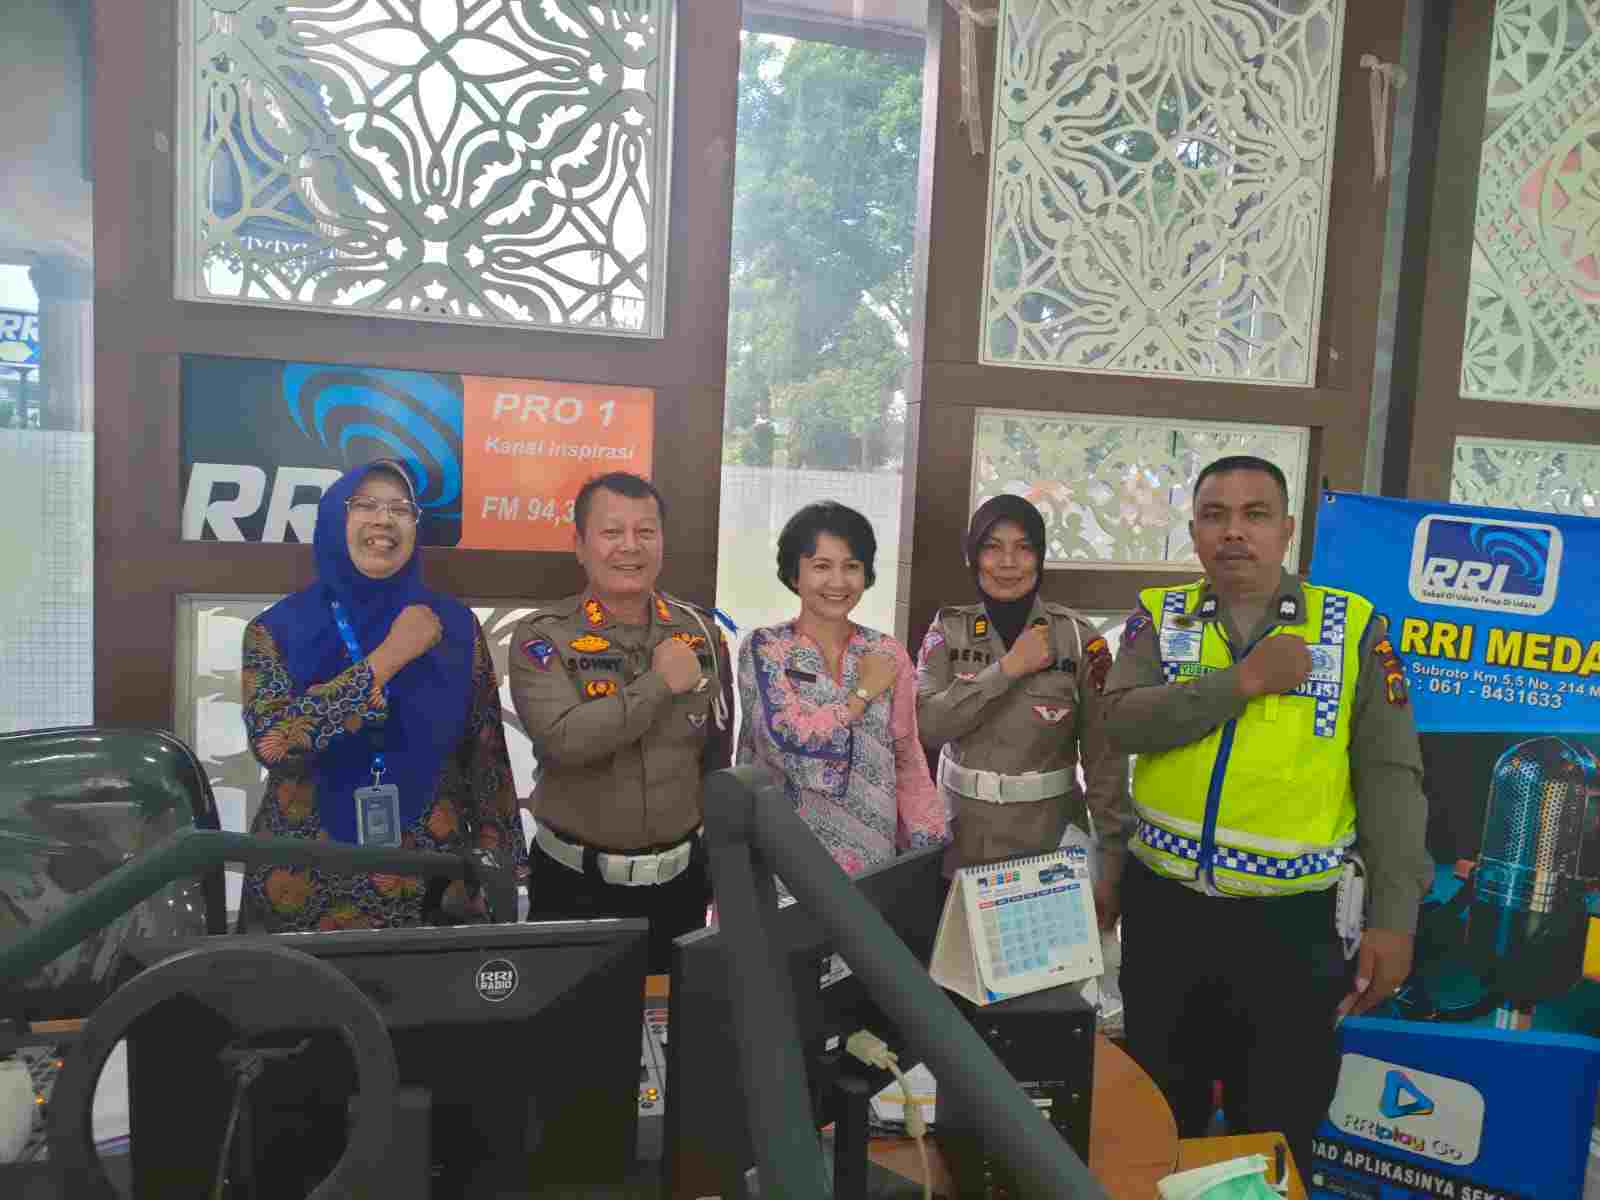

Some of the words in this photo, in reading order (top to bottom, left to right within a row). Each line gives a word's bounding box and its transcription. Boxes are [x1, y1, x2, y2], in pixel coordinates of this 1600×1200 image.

[0, 315, 39, 341] RR
[492, 392, 584, 424] PRO
[599, 399, 616, 427] 1
[483, 435, 544, 457] Kanal
[182, 462, 344, 544] RR
[481, 496, 520, 520] FM
[1423, 557, 1511, 594] RRI
[1400, 617, 1474, 661] RRI
[1484, 627, 1600, 676] MEDA
[1412, 662, 1469, 680] Subroto
[1473, 671, 1498, 684] Km
[1528, 677, 1553, 690] No.
[1558, 681, 1585, 695] 214
[1429, 678, 1461, 695] 061
[1481, 684, 1563, 709] 8431633
[480, 971, 512, 981] RRI
[480, 981, 512, 990] RADIO
[1343, 1150, 1455, 1199] APLIKASINYA
